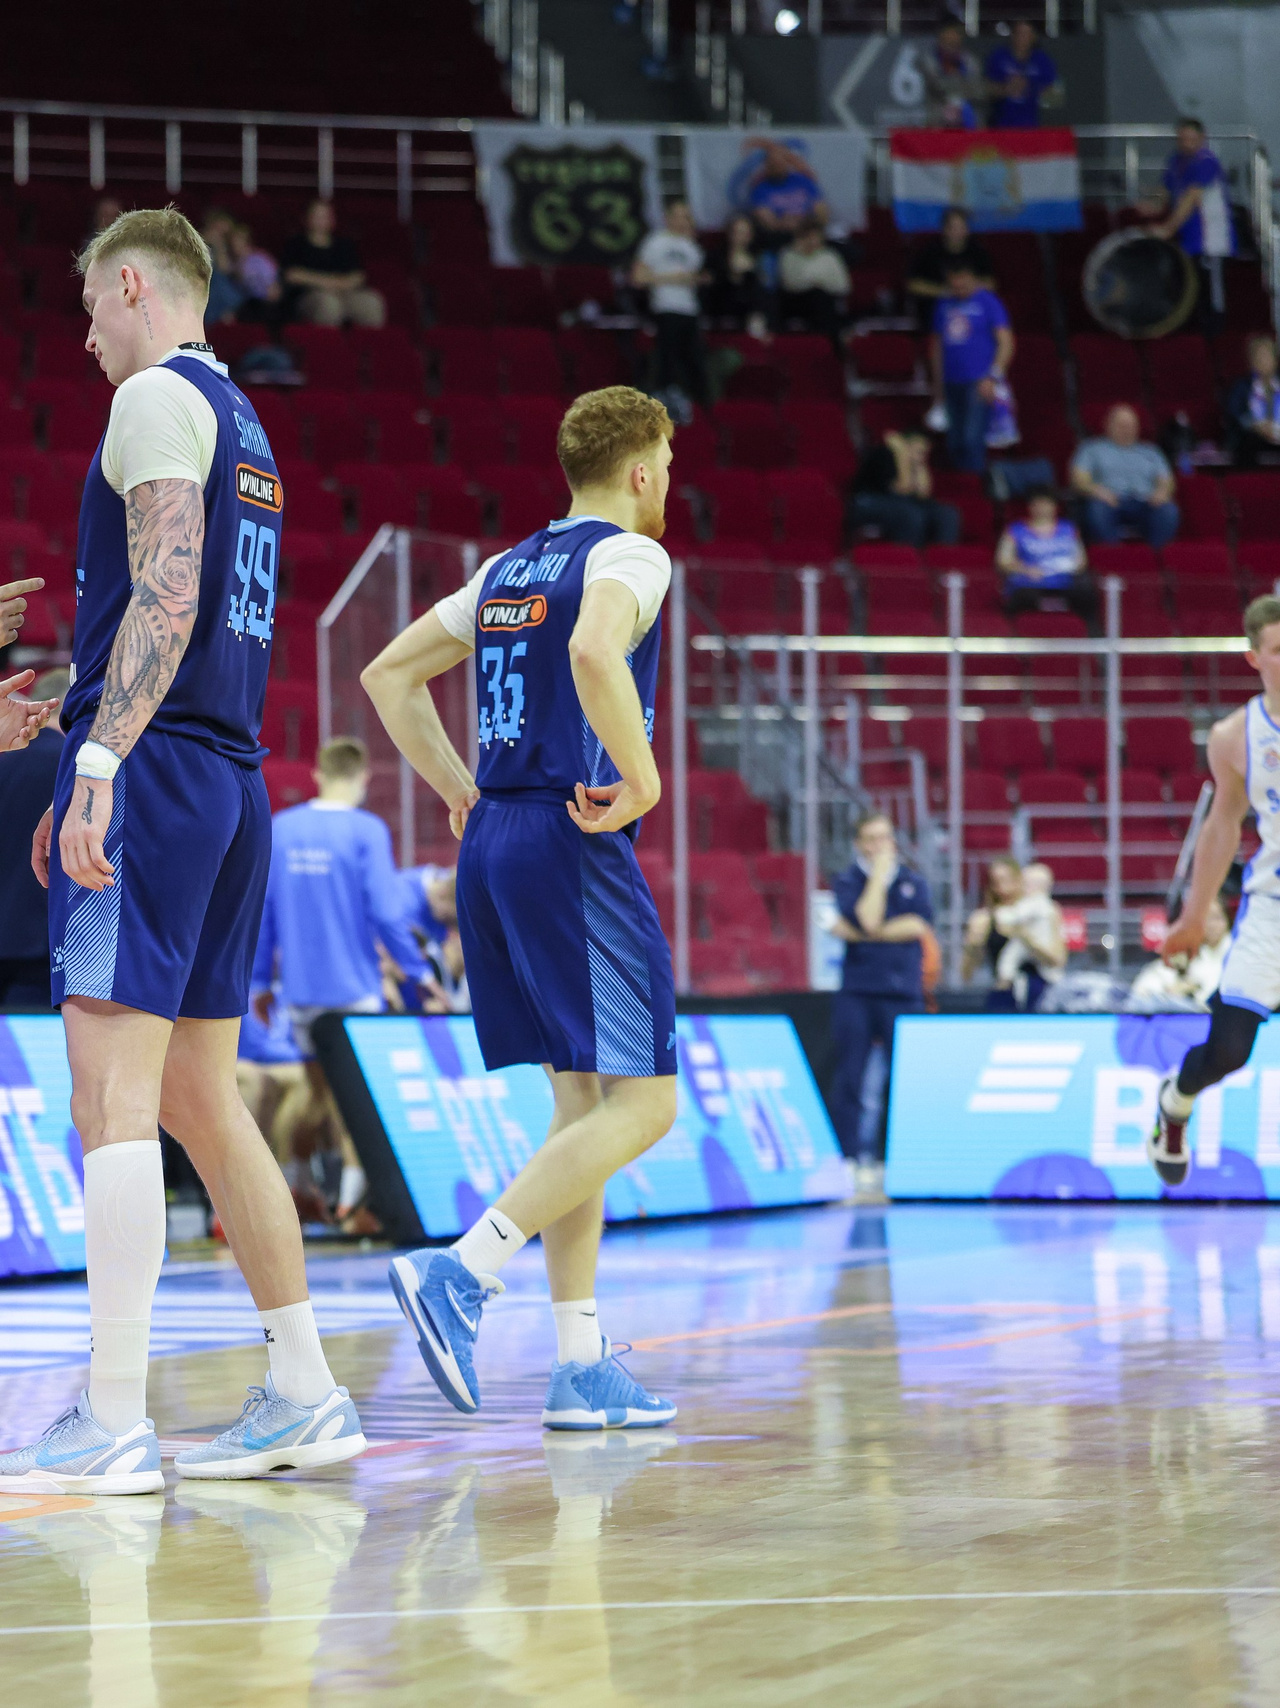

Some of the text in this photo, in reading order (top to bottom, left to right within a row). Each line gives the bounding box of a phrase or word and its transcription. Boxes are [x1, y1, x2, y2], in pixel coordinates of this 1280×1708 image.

[531, 189, 639, 252] 63
[240, 471, 273, 502] WINLINE
[228, 519, 277, 649] 99
[479, 641, 526, 750] 35
